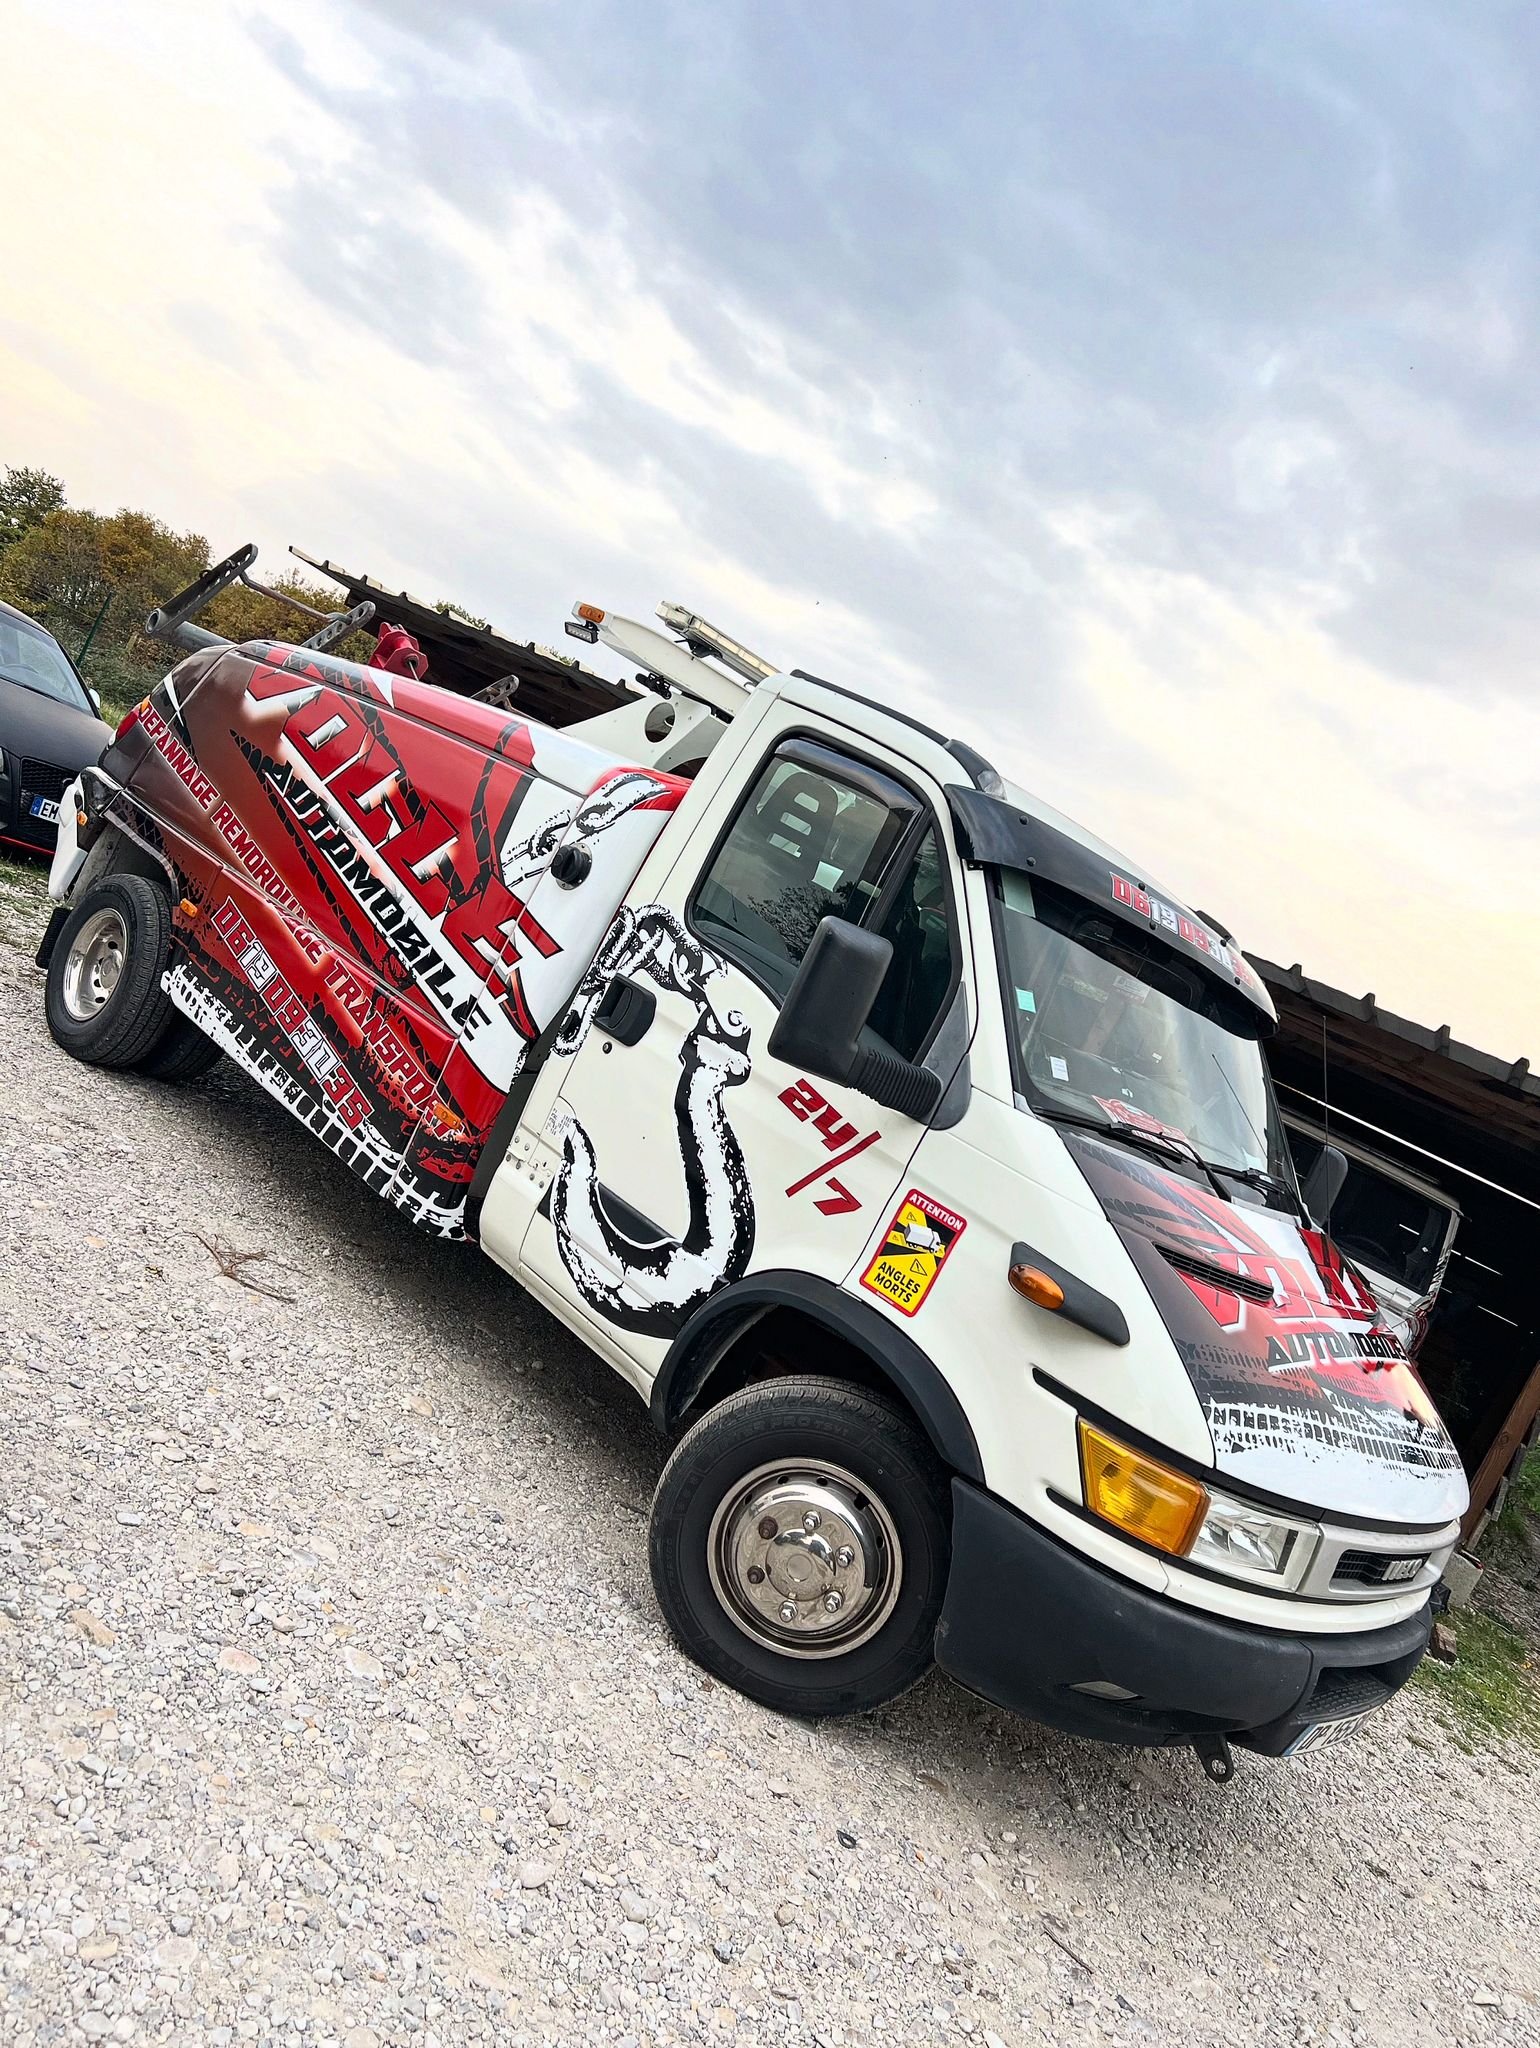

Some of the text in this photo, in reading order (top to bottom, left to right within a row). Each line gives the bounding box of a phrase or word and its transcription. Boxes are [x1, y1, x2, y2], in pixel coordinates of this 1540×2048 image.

[138, 699, 221, 812] DEPANNAGE
[264, 762, 492, 1041] AUTOMOBILE
[211, 896, 375, 1131] 0619093035
[777, 1078, 882, 1216] 24/7
[909, 1193, 963, 1231] ATTENTION
[874, 1273, 913, 1303] MORTS
[878, 1261, 921, 1294] ANGLES
[1265, 1332, 1408, 1366] AUTOMOBILE
